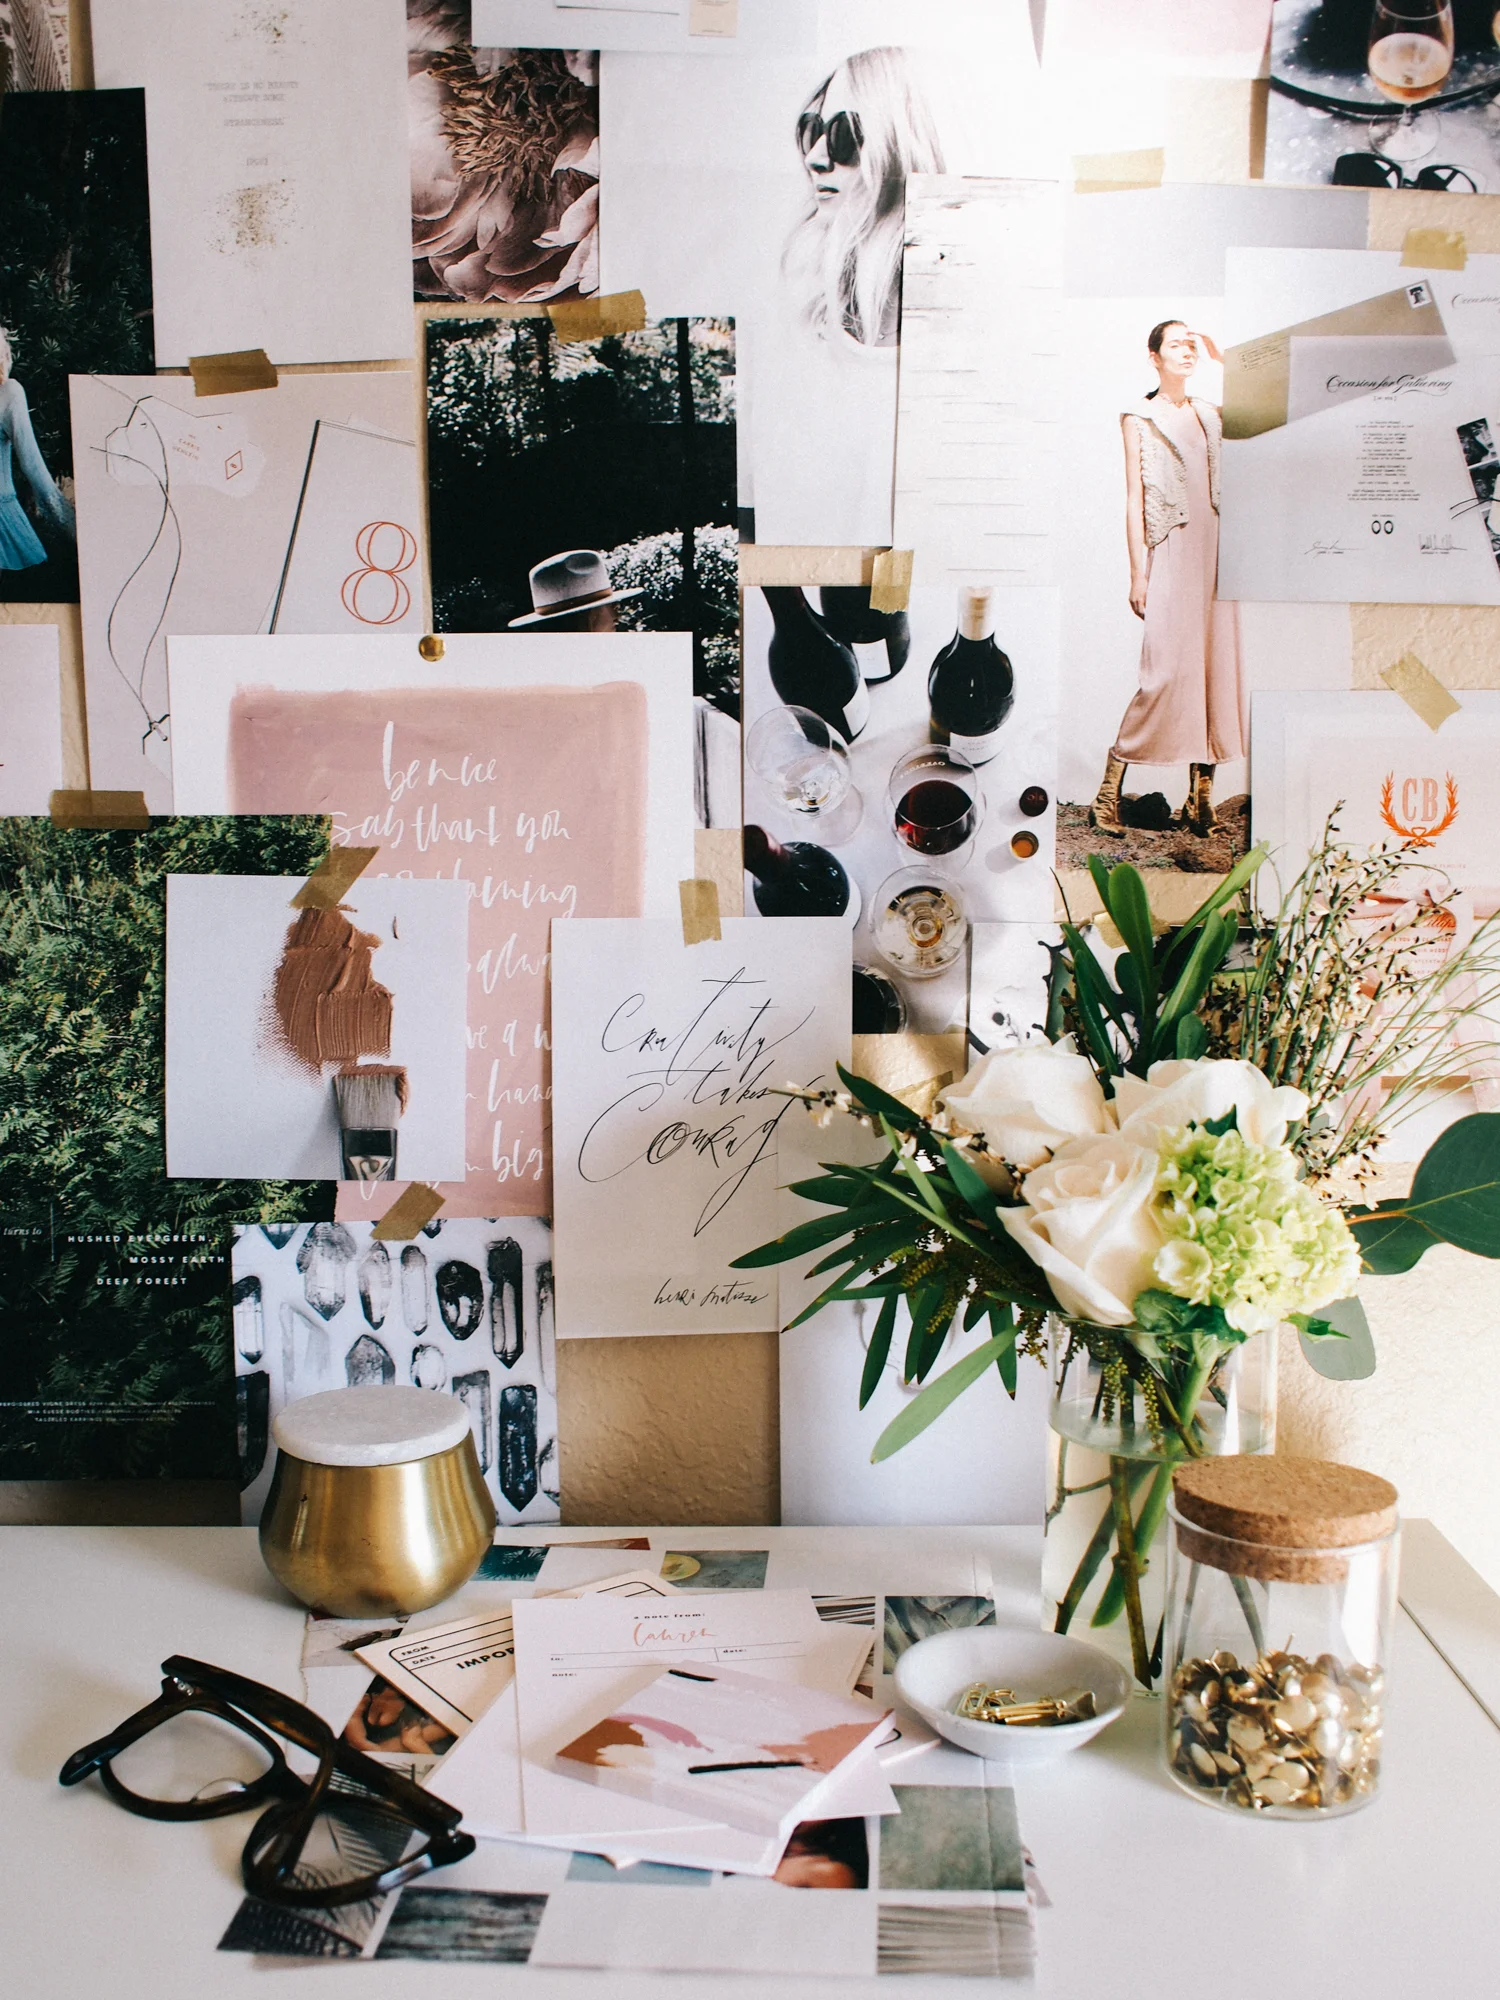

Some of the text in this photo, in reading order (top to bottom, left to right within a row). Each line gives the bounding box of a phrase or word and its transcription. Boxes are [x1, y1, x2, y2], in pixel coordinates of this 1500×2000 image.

[341, 520, 418, 626] 8
[382, 720, 498, 802] be nice
[330, 802, 572, 853] say thank you
[492, 1119, 544, 1183] big
[67, 1235, 121, 1243] HUSHED
[129, 1256, 225, 1264] MOSSY EARTH
[96, 1277, 187, 1286] DEEP FOREST
[401, 1645, 430, 1657] FROM
[411, 1655, 437, 1666] DATE
